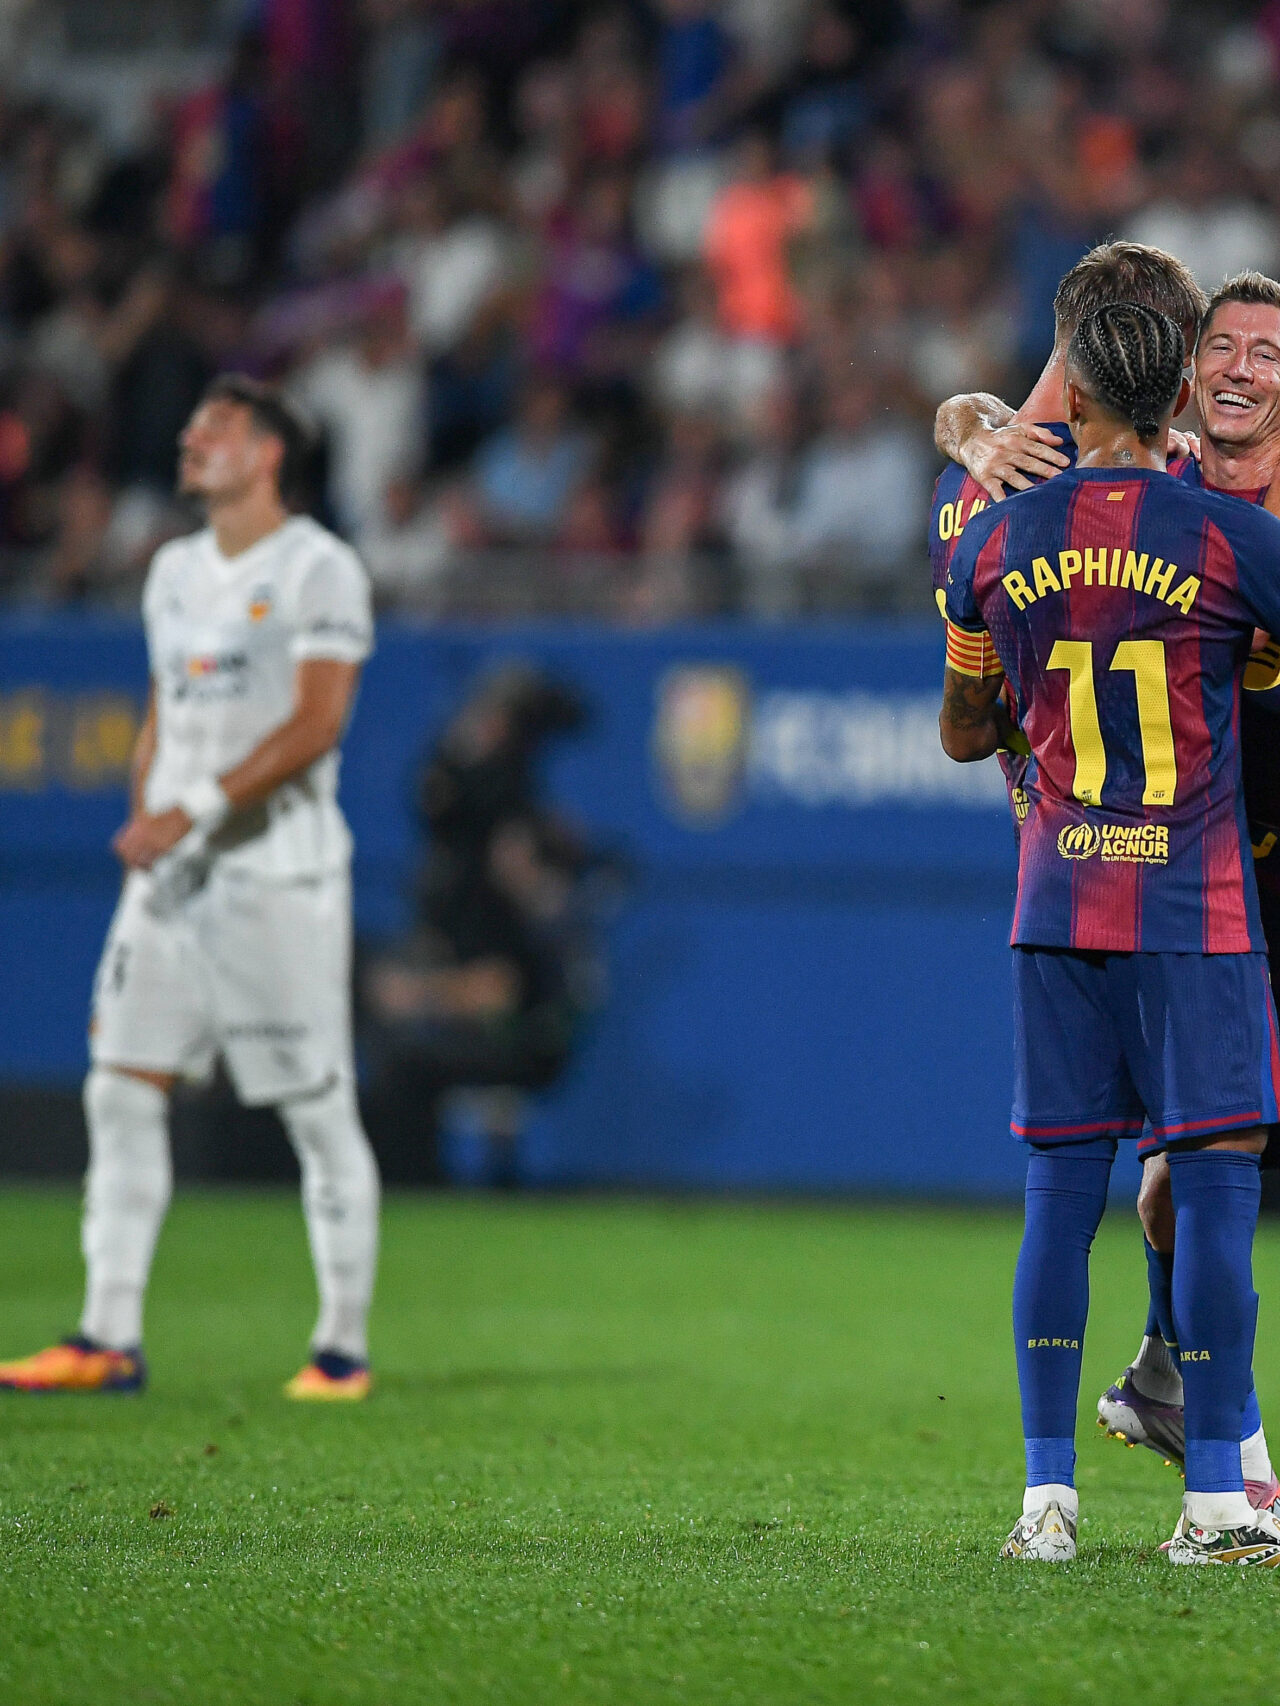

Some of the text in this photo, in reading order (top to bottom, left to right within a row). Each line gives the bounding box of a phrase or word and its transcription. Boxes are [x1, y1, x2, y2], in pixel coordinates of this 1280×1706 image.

[1001, 547, 1201, 615] RAPHINHA
[1045, 640, 1178, 806] 11
[1101, 824, 1169, 841] UNHCR
[1100, 840, 1169, 857] ACNUR
[1145, 857, 1169, 865] Agency
